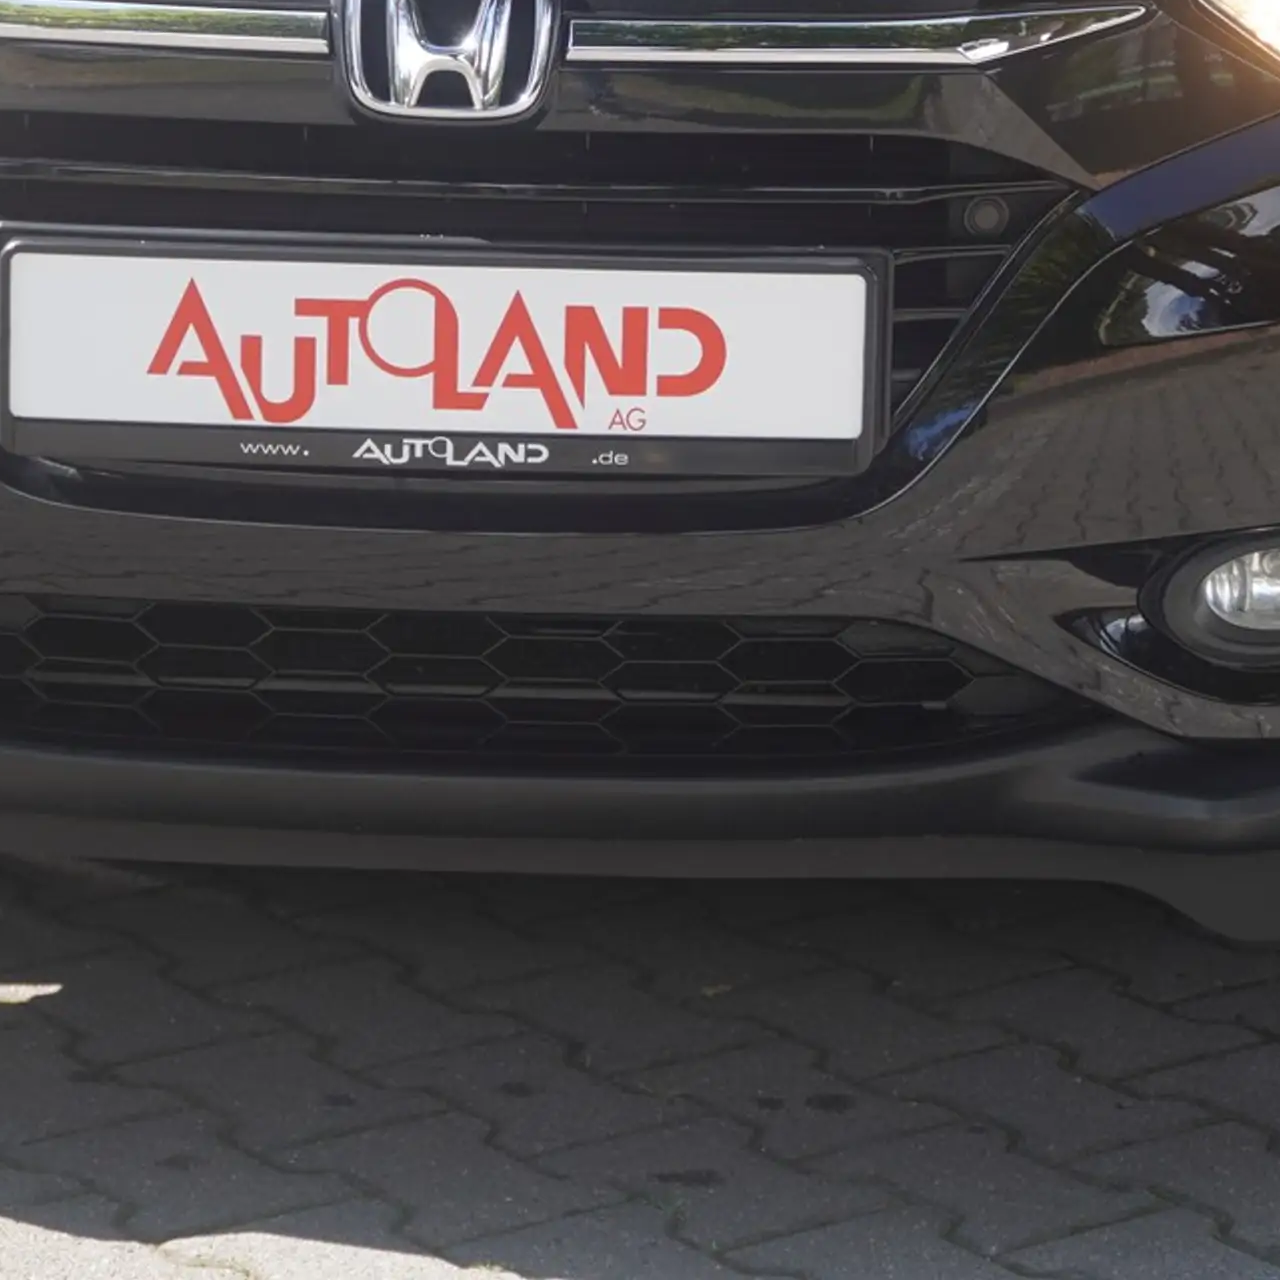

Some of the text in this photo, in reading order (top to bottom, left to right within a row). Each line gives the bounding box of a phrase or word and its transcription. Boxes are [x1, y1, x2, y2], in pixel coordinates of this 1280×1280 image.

[608, 407, 647, 431] AG
[240, 441, 310, 457] www.
[590, 450, 629, 466] .de
